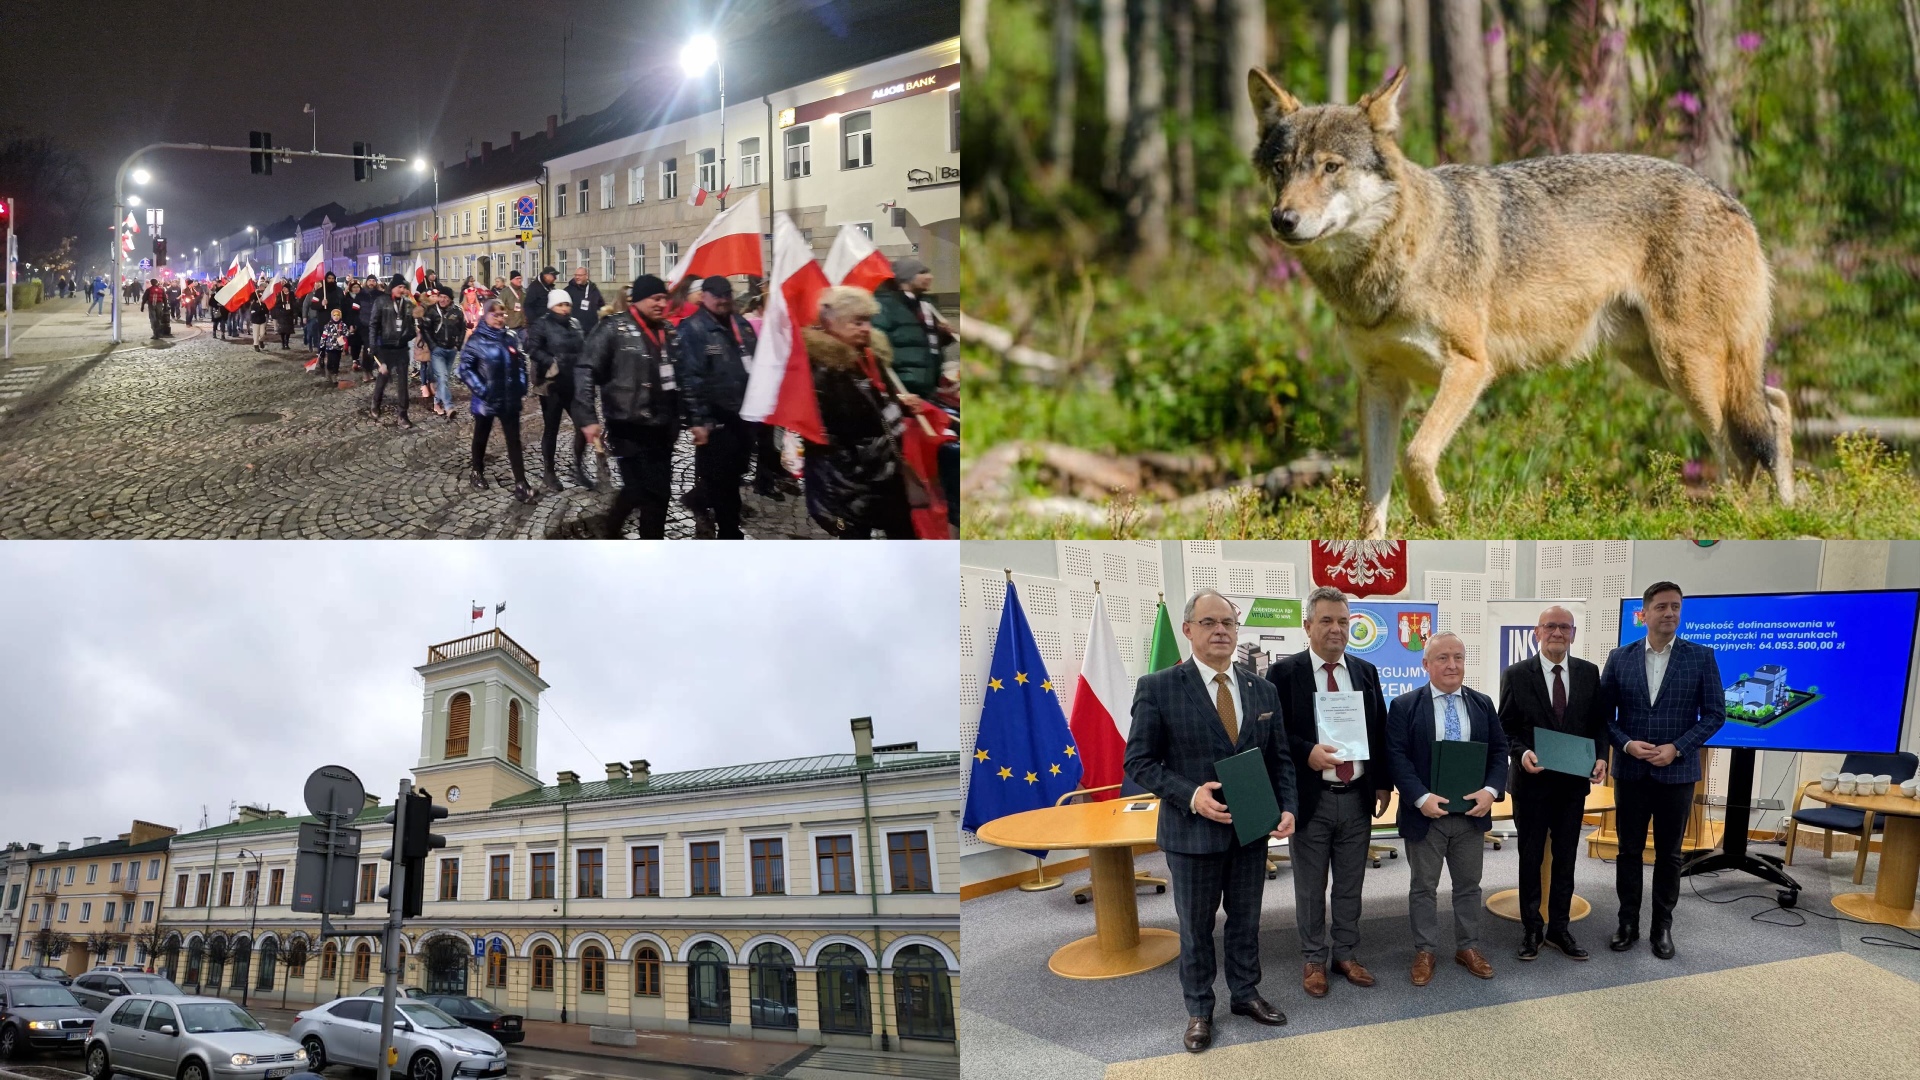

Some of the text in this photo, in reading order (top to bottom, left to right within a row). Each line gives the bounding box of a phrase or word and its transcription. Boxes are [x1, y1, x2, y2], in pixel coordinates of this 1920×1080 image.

[872, 75, 936, 99] ALIOR BANK
[941, 166, 959, 179] Ba
[1685, 621, 1734, 631] Wysokość
[1737, 620, 1823, 629] dofinansowania
[1680, 632, 1712, 640] formie
[1714, 631, 1758, 641] pożyczki
[1777, 630, 1838, 639] warunkach
[1508, 629, 1540, 666] INS
[1758, 641, 1834, 651] 64.053.500,00
[1836, 641, 1846, 650] zł
[477, 940, 484, 955] P
